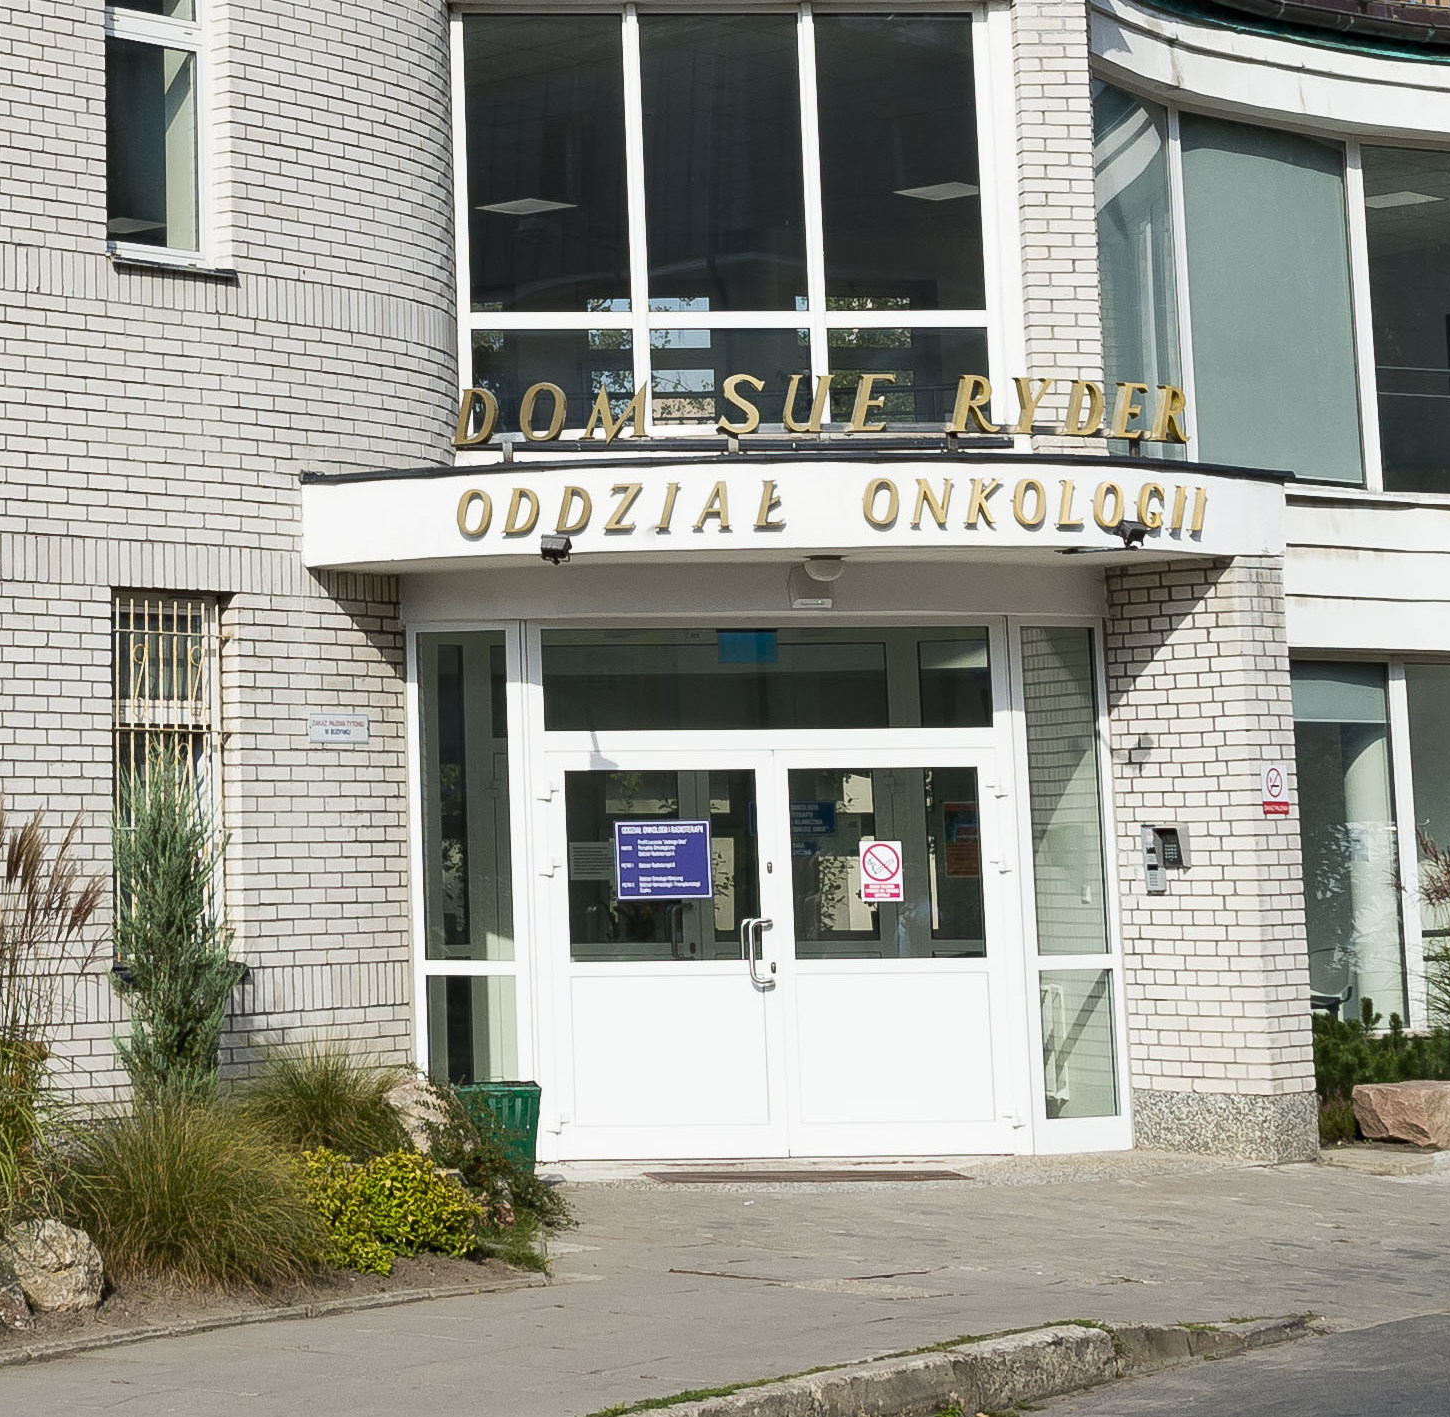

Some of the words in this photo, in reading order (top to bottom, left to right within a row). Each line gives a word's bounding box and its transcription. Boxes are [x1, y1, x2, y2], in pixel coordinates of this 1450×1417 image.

[452, 380, 649, 446] DOM
[716, 373, 897, 436] SUE
[949, 374, 1191, 442] RYDER
[456, 479, 787, 537] ODDZIAŁ
[862, 477, 1206, 537] ONKOLOGII
